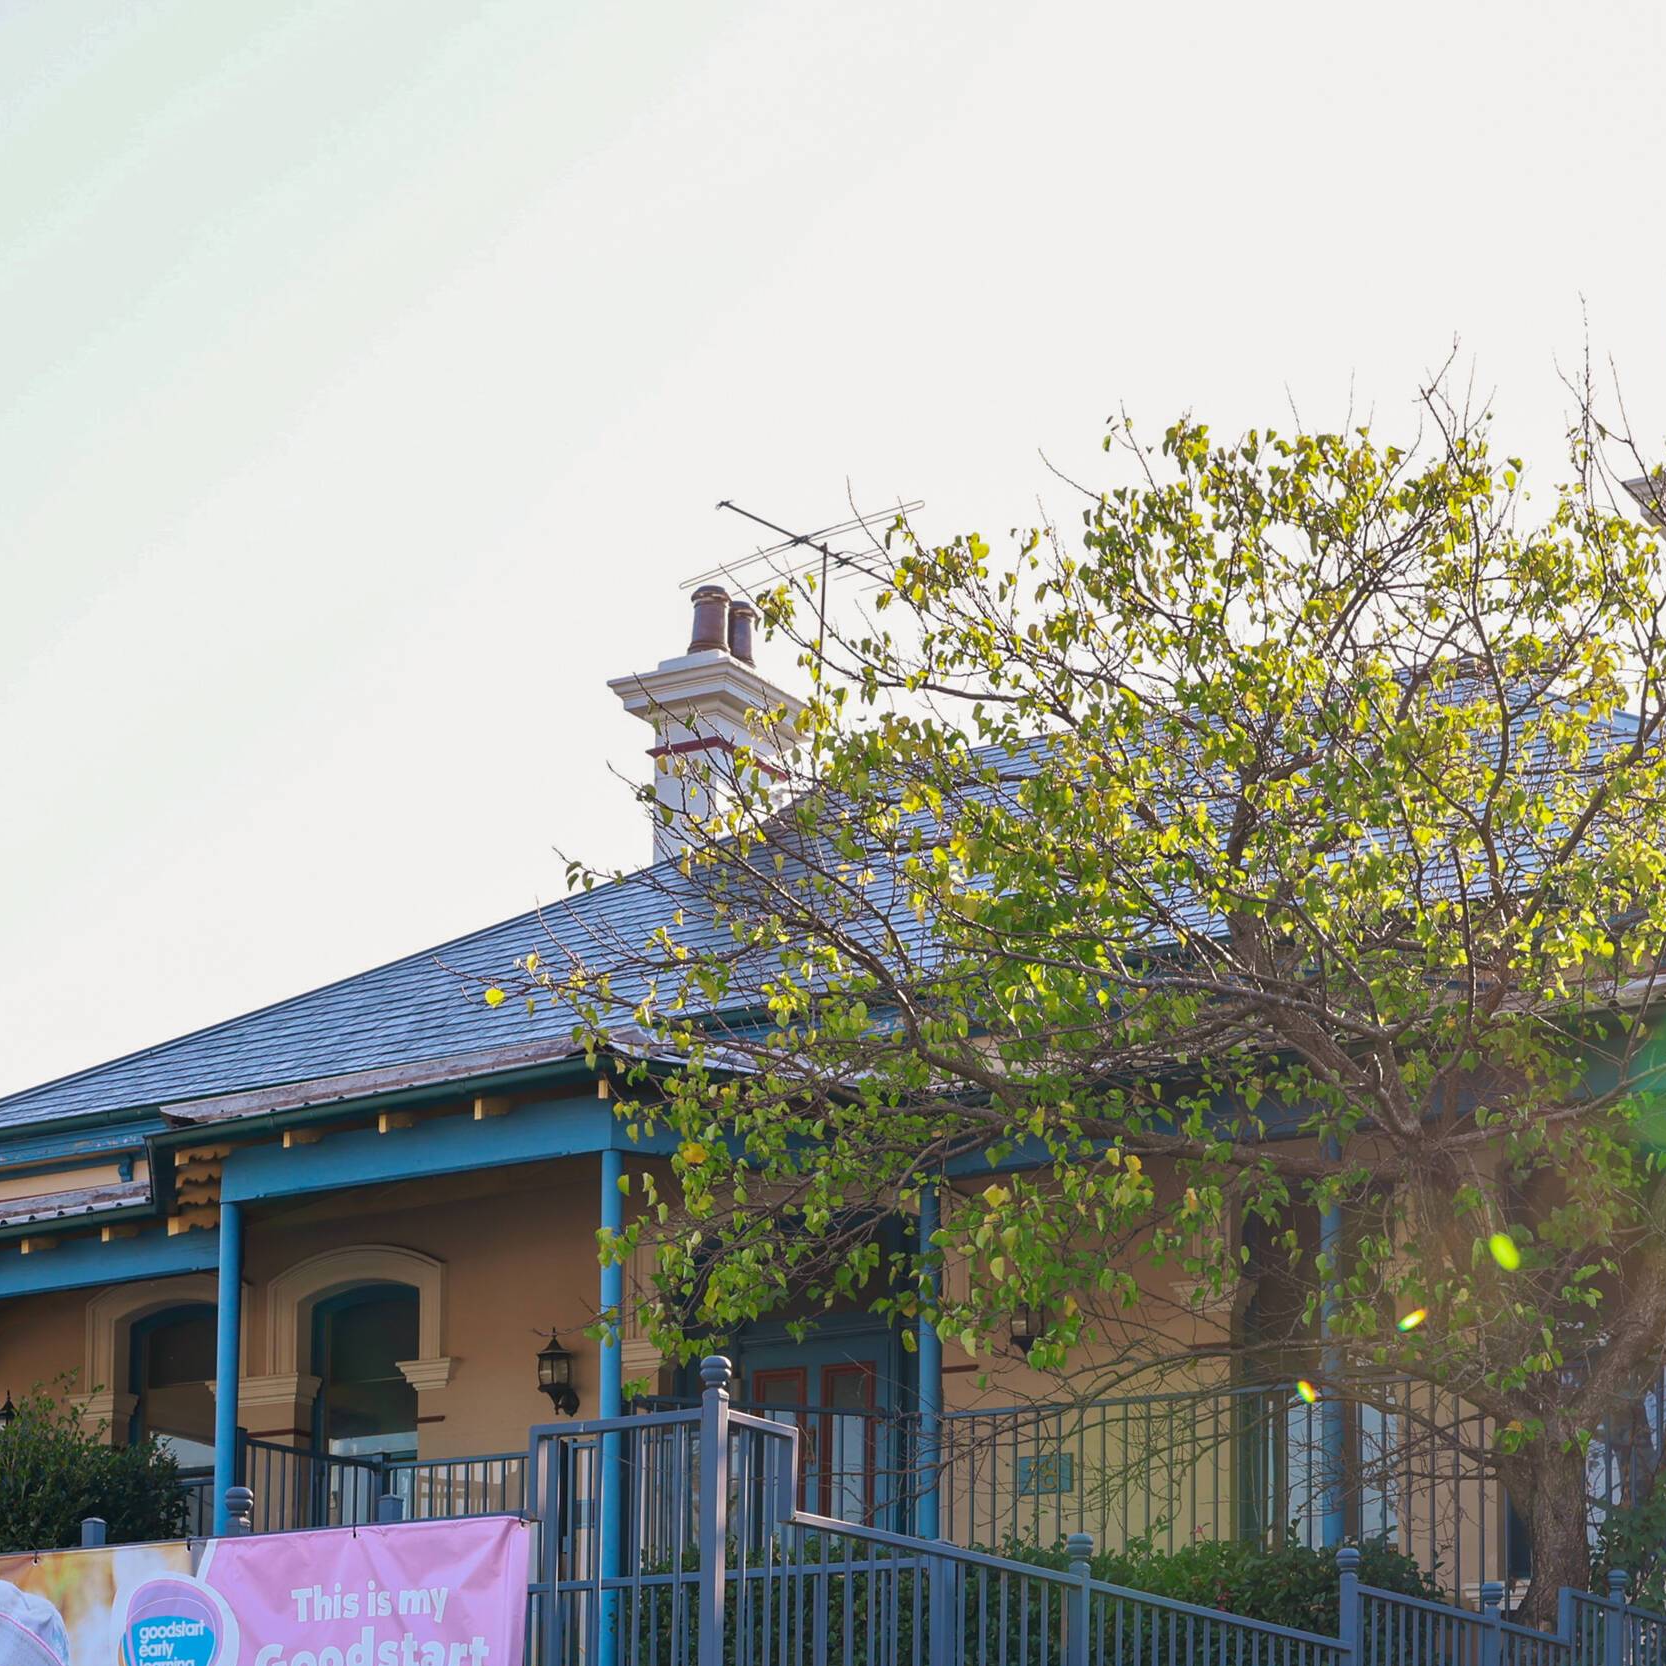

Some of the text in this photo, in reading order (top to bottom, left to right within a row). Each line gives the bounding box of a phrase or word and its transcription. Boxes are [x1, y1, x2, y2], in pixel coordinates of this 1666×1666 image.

[291, 1580, 449, 1623] This is my
[139, 1619, 204, 1644] goodstart
[139, 1641, 174, 1659] early
